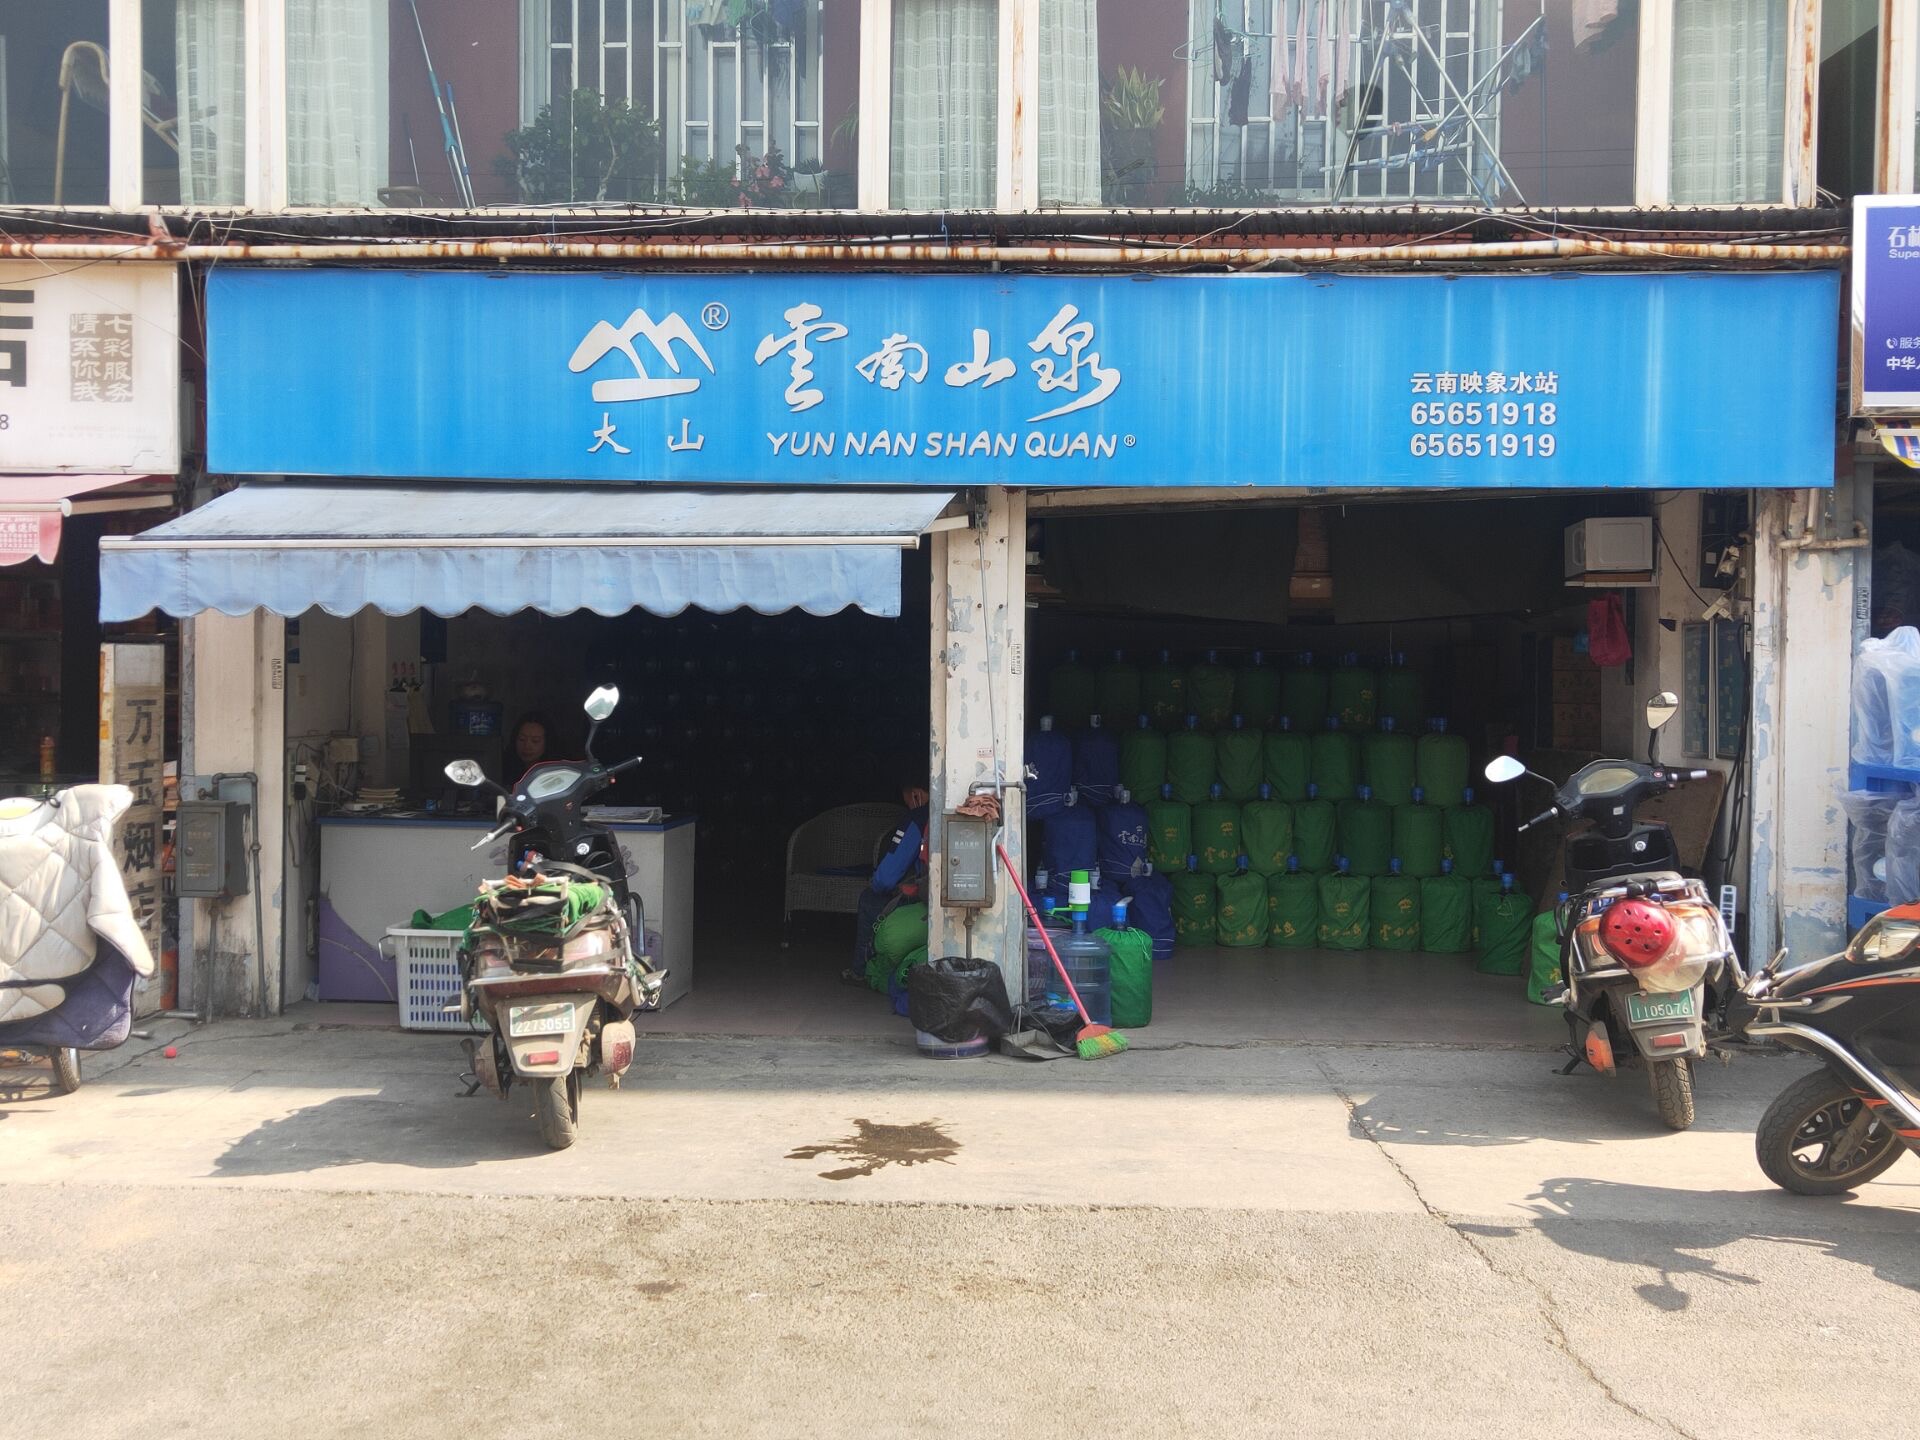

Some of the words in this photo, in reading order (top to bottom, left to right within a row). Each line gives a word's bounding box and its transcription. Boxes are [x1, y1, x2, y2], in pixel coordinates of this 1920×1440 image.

[1888, 248, 1920, 259] Supe
[71, 314, 104, 403] 情系你我
[104, 315, 134, 402] 七彩服务
[1411, 371, 1558, 394] 云南映象水站
[1411, 402, 1556, 425] 65651918
[588, 413, 704, 455] 大山
[766, 431, 835, 456] YUN
[844, 431, 917, 457] NAN
[924, 431, 1017, 458] SHAN
[1410, 433, 1555, 457] 65651919
[1636, 1002, 1689, 1019] 1105076
[515, 1017, 570, 1033] 2273055
